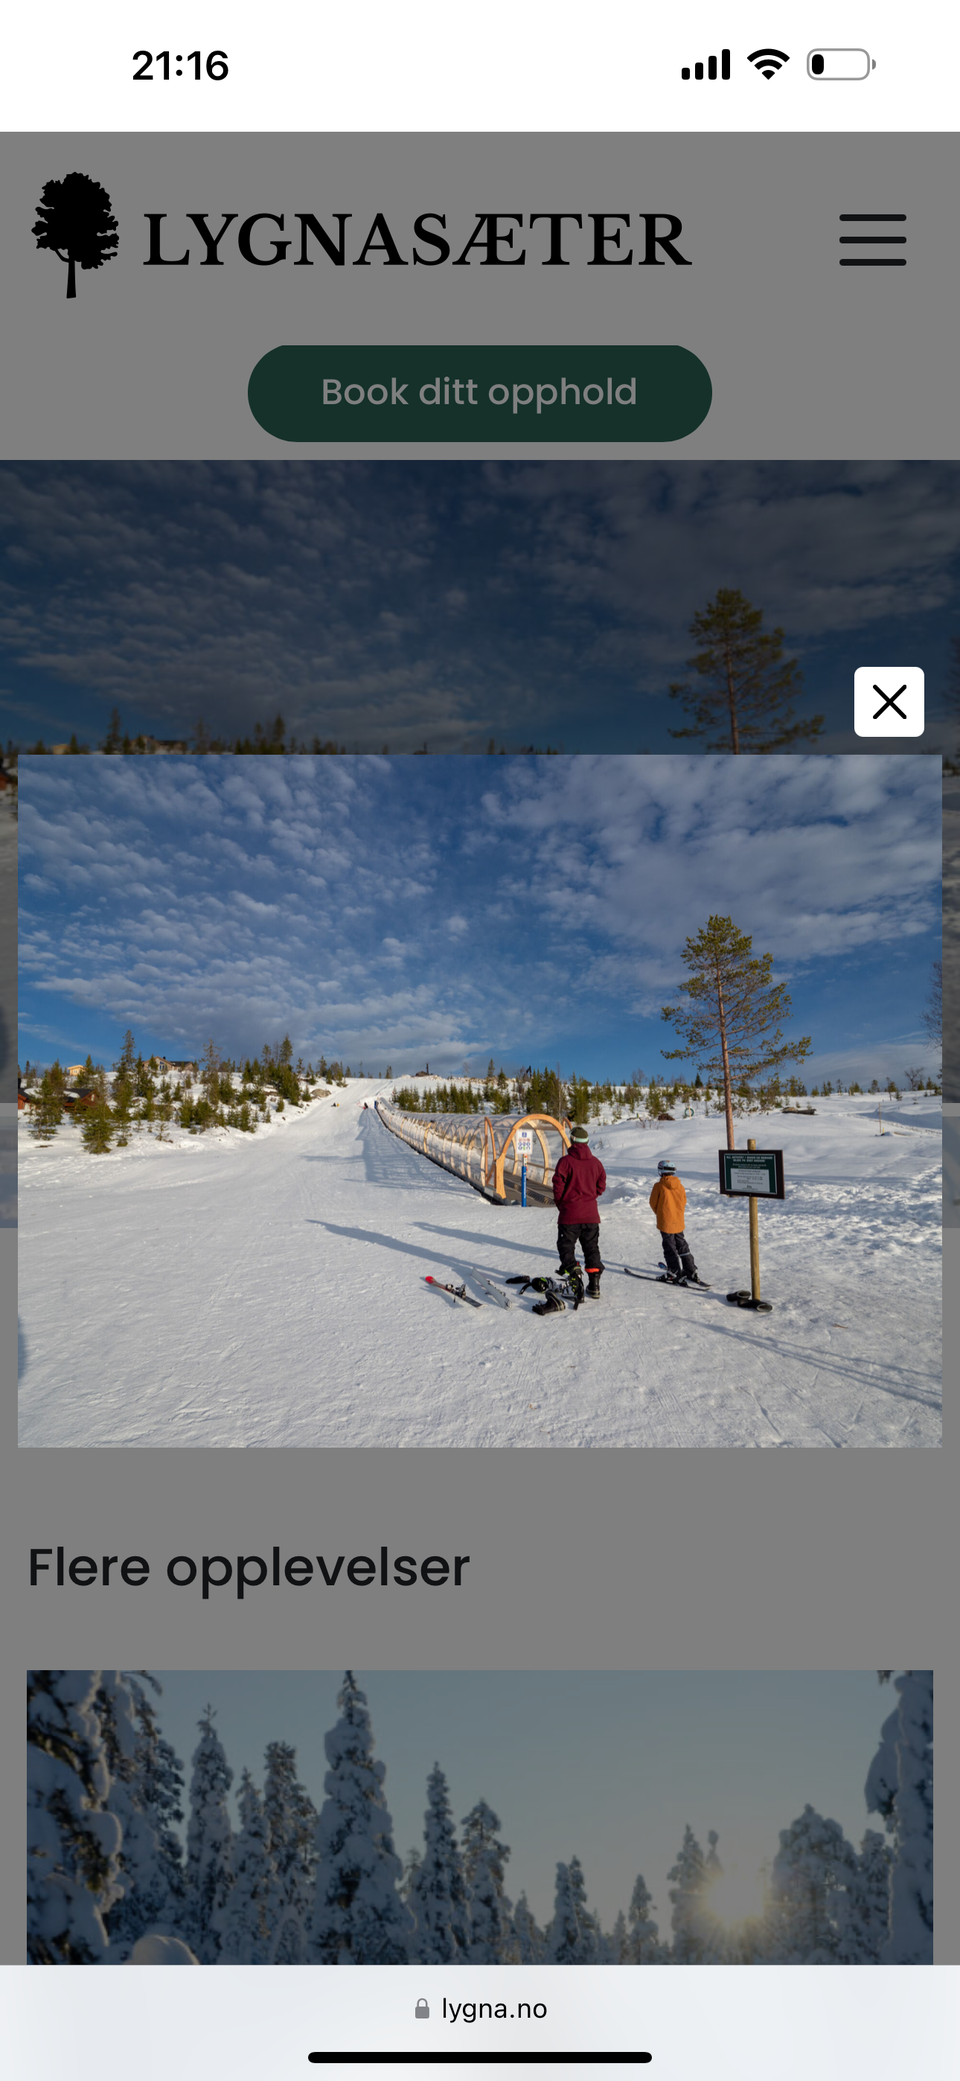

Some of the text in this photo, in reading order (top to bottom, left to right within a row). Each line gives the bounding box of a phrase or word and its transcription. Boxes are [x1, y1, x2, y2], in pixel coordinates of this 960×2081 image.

[132, 49, 230, 82] 21:16
[143, 212, 693, 267] LYGNASÆTER
[322, 376, 637, 415] Book ditt opphold
[29, 1546, 471, 1600] Flere opplevelser
[441, 1997, 548, 2024] lygna.no
